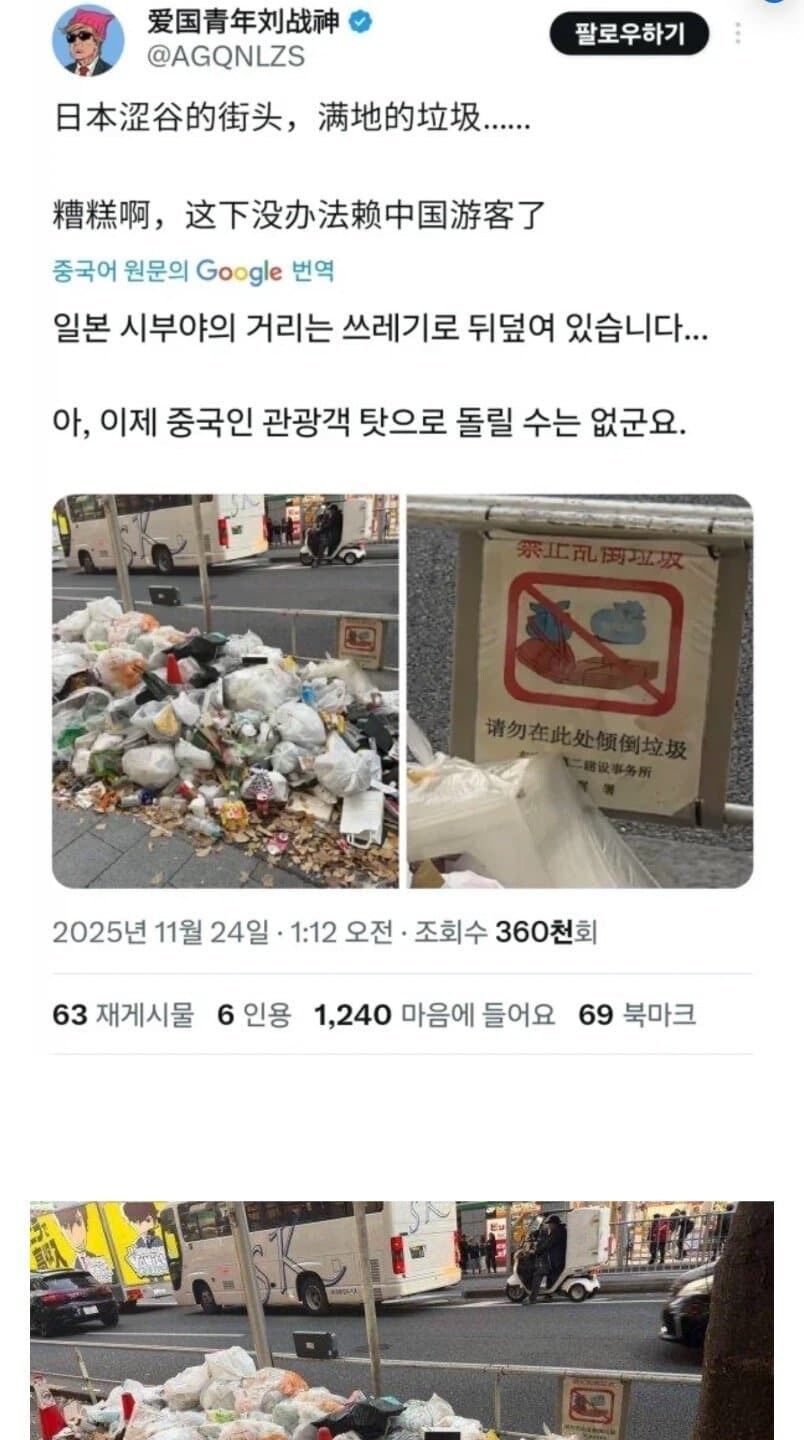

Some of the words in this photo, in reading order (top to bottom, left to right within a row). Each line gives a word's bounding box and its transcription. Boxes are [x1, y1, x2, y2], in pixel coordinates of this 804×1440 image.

[147, 7, 340, 35] 爱国青年刘战神
[575, 21, 685, 47] 팔로우하기
[147, 44, 305, 70] @AGQNLZS
[52, 259, 117, 283] 중국어
[124, 259, 189, 283] 원문의
[196, 259, 283, 288] Google
[292, 259, 335, 283] 번역
[53, 312, 112, 344] 일본
[119, 312, 235, 344] 시부야의
[246, 312, 334, 344] 거리는
[341, 312, 460, 344] 쓰레기로
[467, 312, 555, 344] 뒤덮여
[565, 312, 708, 344] 있습니다...
[52, 406, 91, 440] 아,
[100, 406, 157, 438] 이제
[166, 406, 253, 439] 중국인
[262, 406, 350, 439] 관광객
[360, 406, 448, 438] 탓으로
[455, 406, 513, 439] 돌릴
[522, 407, 582, 438] 수는
[590, 407, 686, 438] 없군요.
[485, 717, 688, 761] 请勿在此处倾倒垃圾
[52, 919, 147, 945] 2025년
[155, 919, 203, 946] 11월
[210, 919, 269, 946] 24일
[290, 920, 337, 943] 1:12
[344, 919, 393, 945] 오전
[414, 919, 489, 945] 조회수
[495, 918, 598, 946] 360천회
[52, 1003, 88, 1026] 63
[96, 1002, 195, 1029] 재게시물
[217, 1003, 235, 1026] 6
[243, 1002, 292, 1029] 인용
[314, 1003, 392, 1030] 1,240
[402, 1002, 475, 1028] 마음에
[482, 1002, 556, 1029] 들어요
[578, 1003, 614, 1026] 69
[623, 1002, 697, 1029] 북마크
